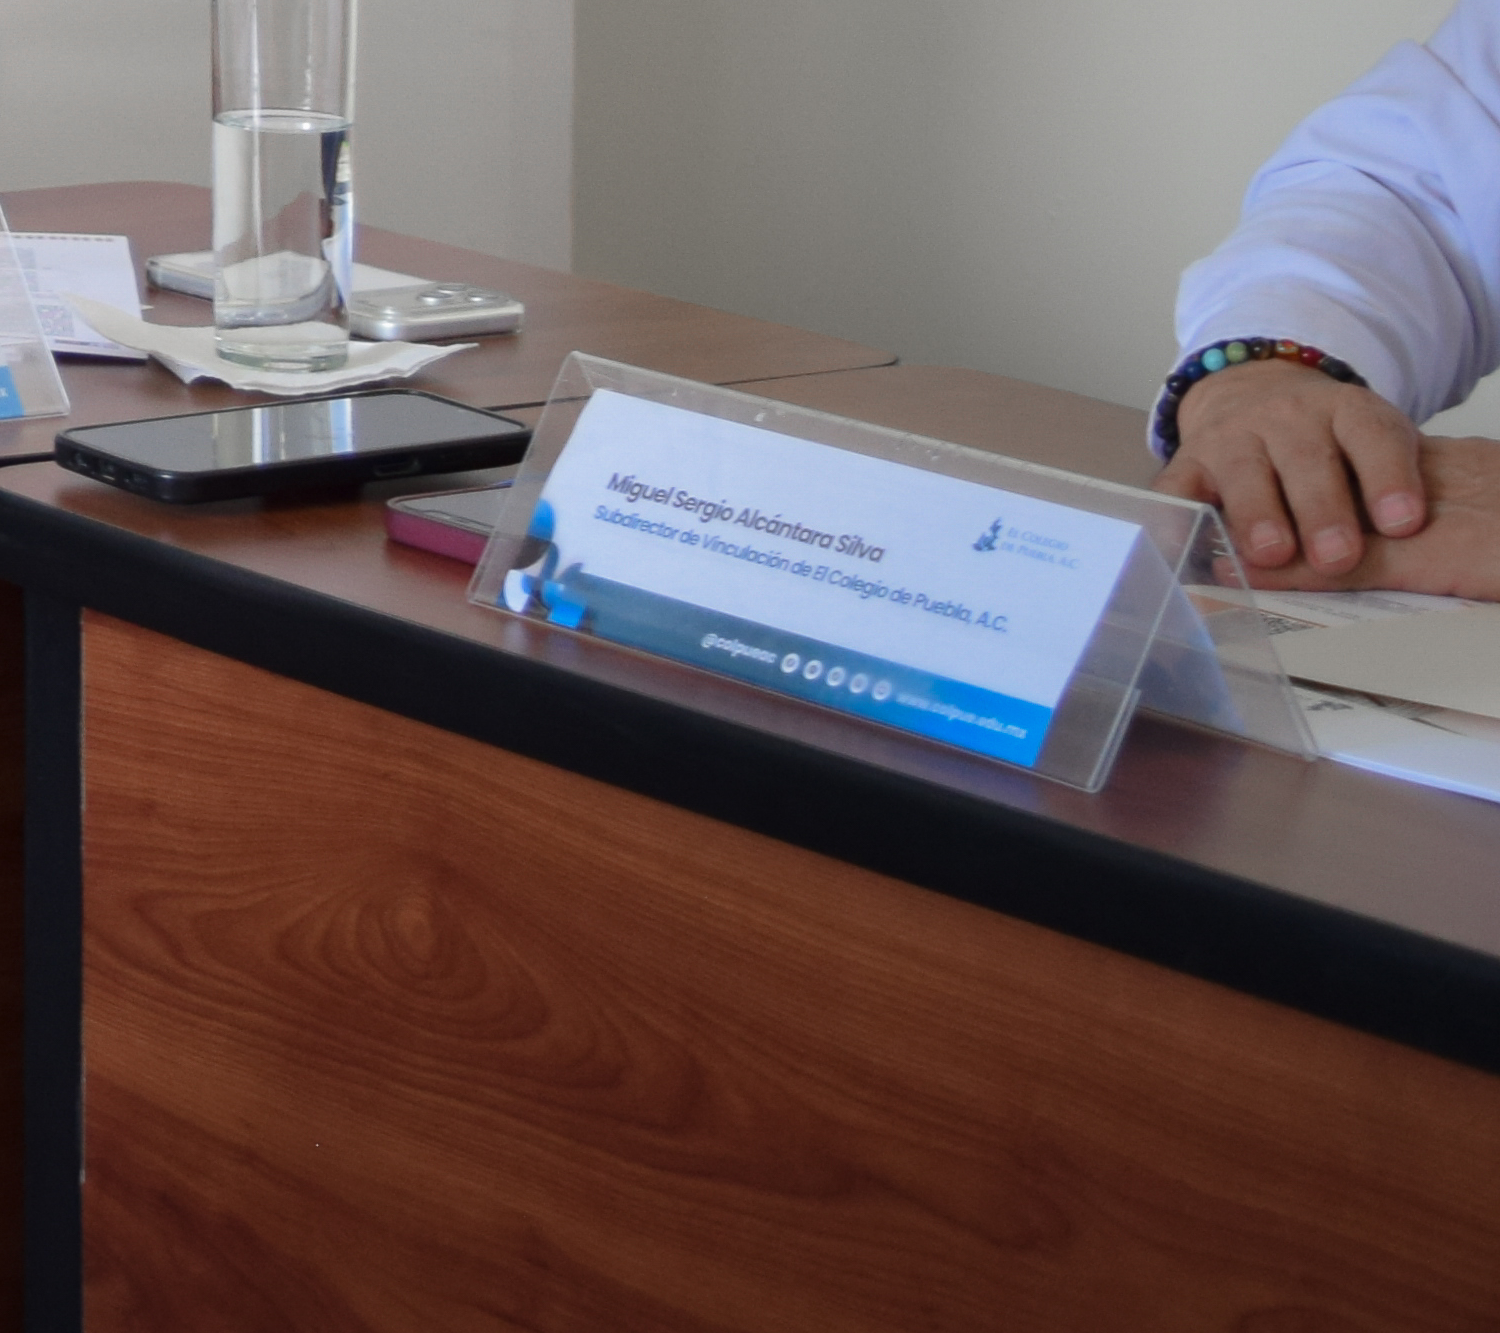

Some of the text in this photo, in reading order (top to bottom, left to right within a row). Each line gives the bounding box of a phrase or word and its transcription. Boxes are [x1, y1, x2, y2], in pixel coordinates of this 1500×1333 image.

[594, 504, 1008, 633] Subdirector de Vinculación de El Colegio de Puebla, A.C.
[607, 472, 885, 563] Miguel Sergio Alcántara Silva
